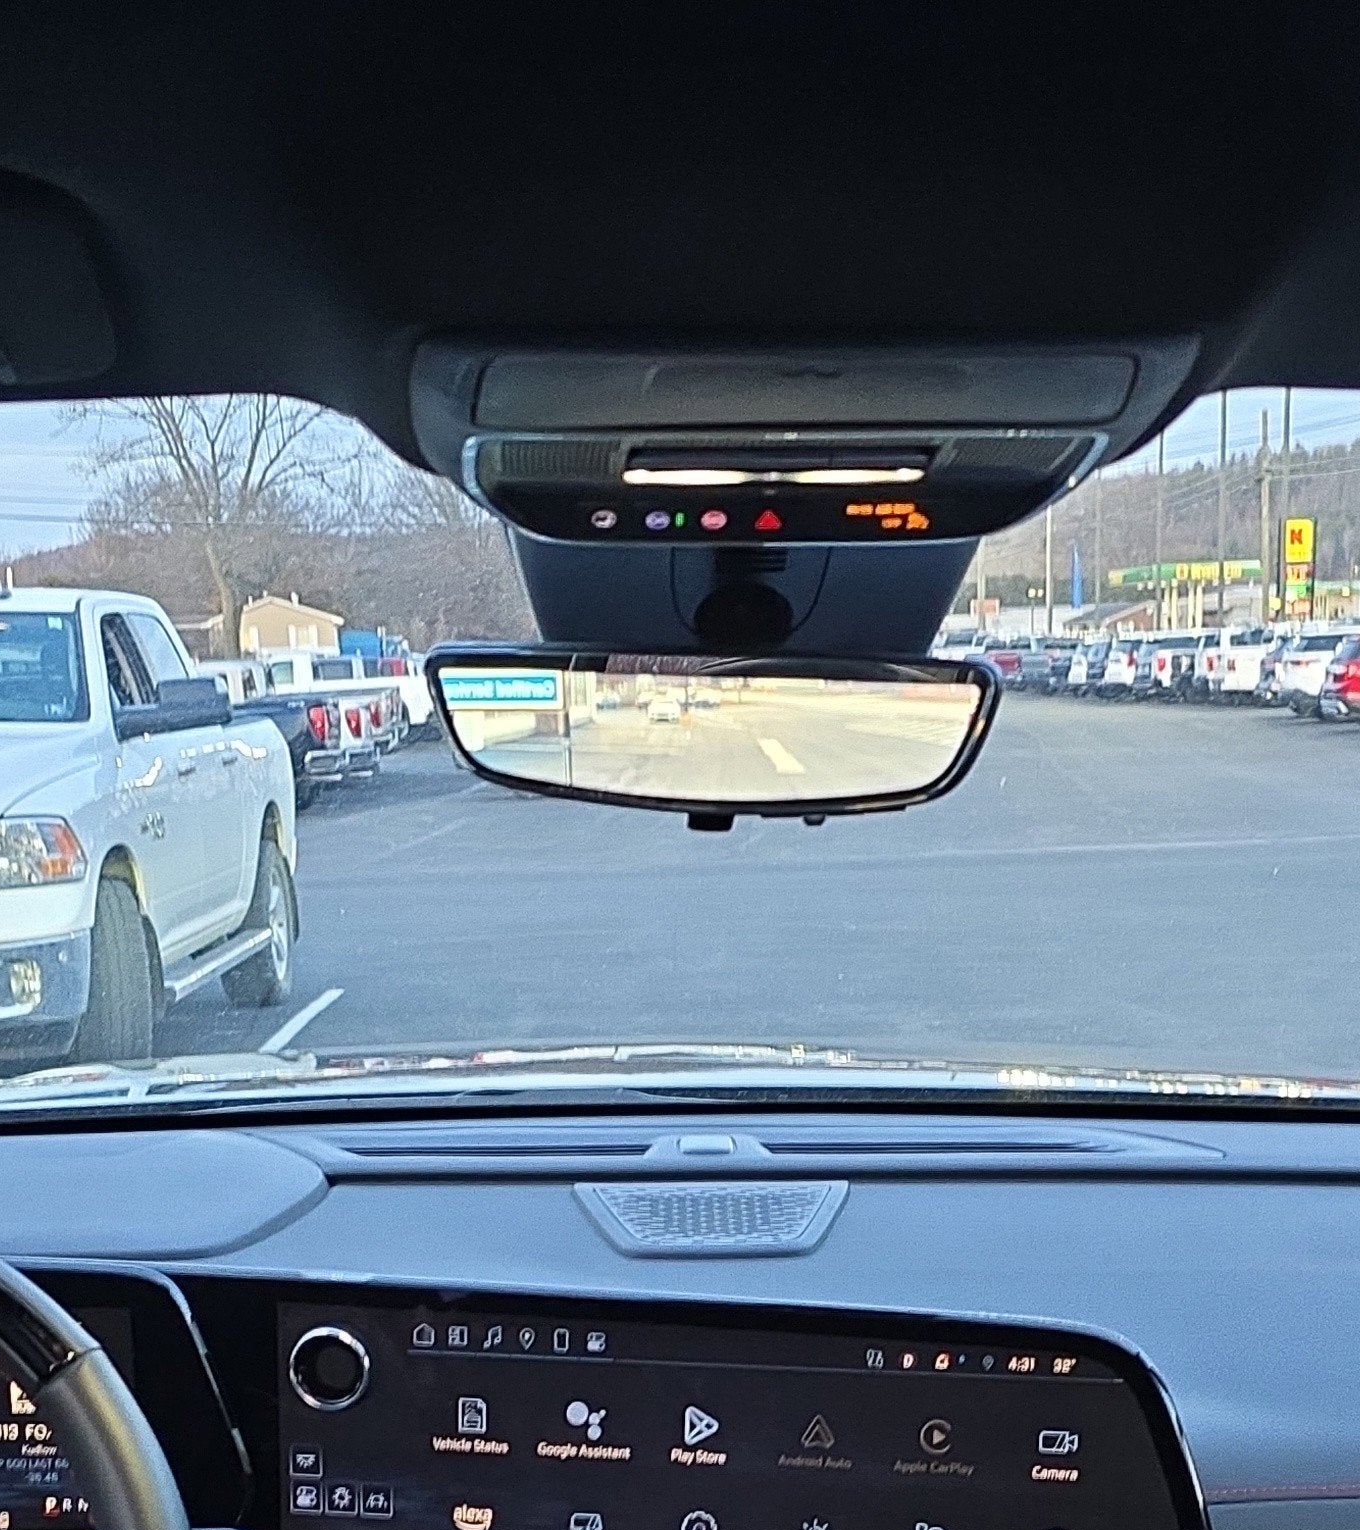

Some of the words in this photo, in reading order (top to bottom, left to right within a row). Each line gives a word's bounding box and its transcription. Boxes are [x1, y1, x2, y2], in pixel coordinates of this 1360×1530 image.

[25, 1423, 52, 1441] FO
[432, 1436, 472, 1453] Vehicle
[473, 1438, 510, 1455] Status
[536, 1441, 578, 1461] Google
[578, 1443, 631, 1461] Assistant
[670, 1447, 695, 1467] Play
[695, 1449, 727, 1466] Store
[777, 1454, 823, 1468] Android
[824, 1456, 853, 1469] Auto
[893, 1459, 928, 1476] Apple
[929, 1461, 975, 1477] CarPlay
[1031, 1465, 1079, 1482] Camera
